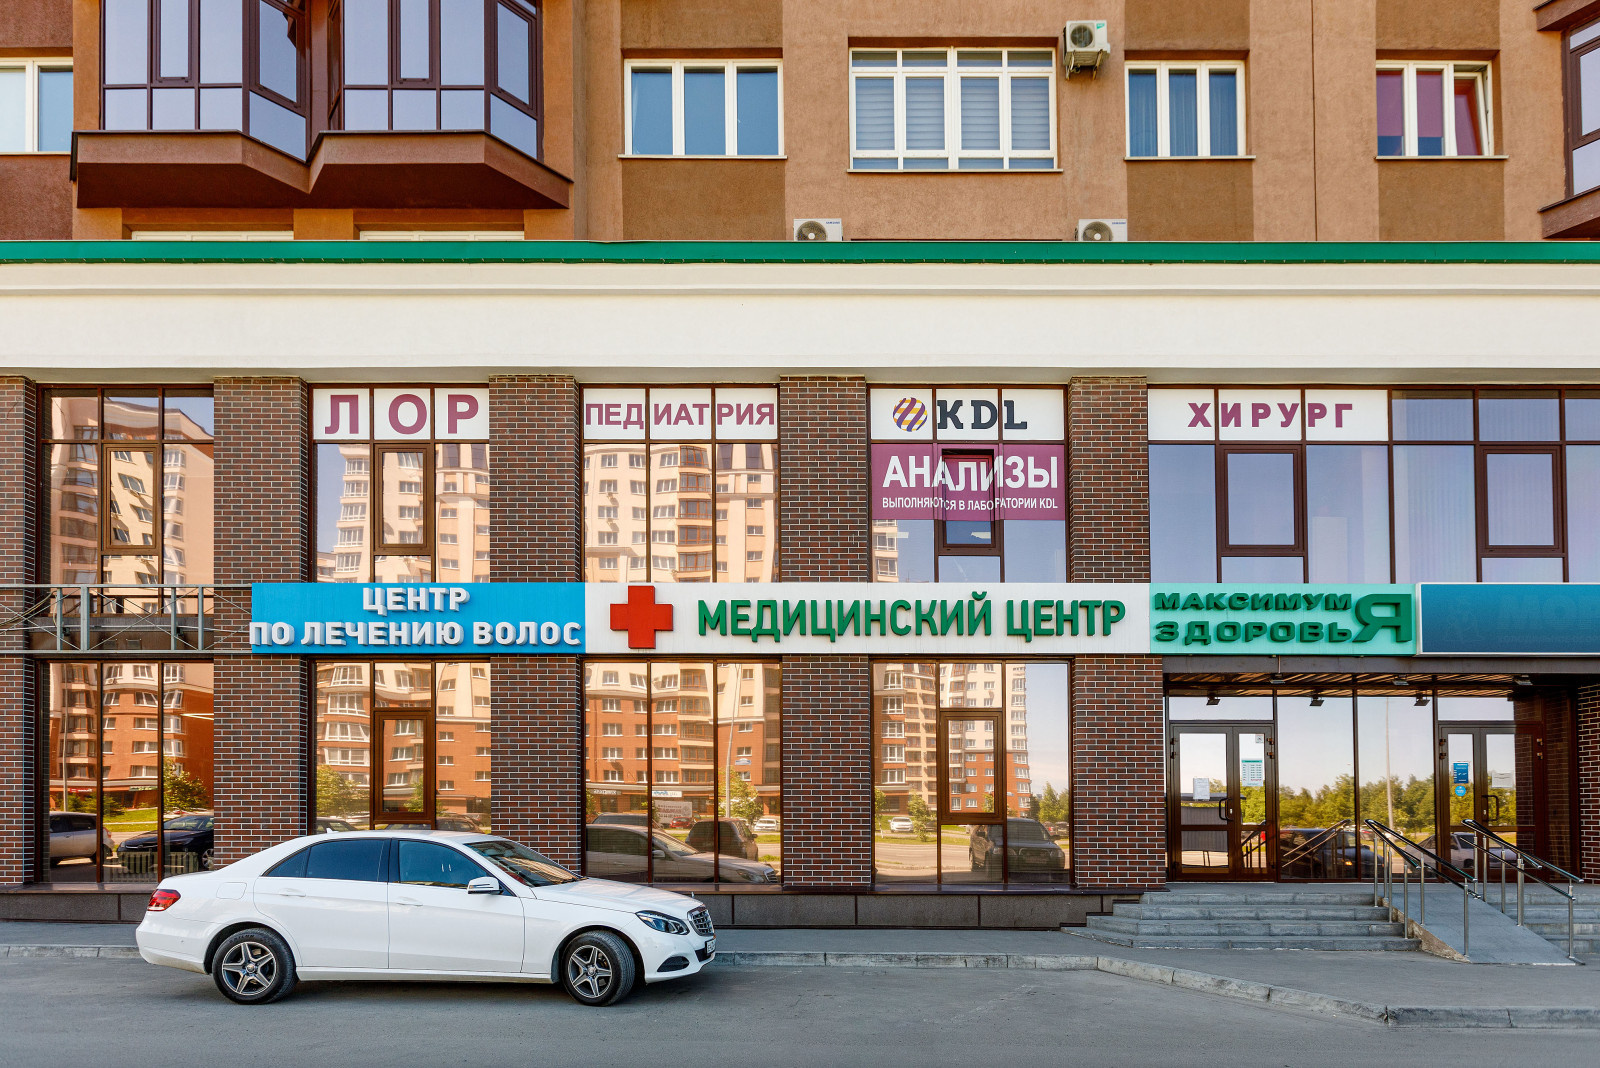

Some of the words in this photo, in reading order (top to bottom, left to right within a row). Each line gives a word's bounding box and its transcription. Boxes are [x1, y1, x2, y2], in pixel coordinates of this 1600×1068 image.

[325, 394, 479, 435] ЛОР
[585, 403, 775, 429] ПЕДИАТРИЯ
[937, 400, 1028, 430] KDL
[1187, 402, 1353, 428] ХИРУРГ
[882, 455, 1058, 492] АНАЛИЗЫ
[958, 500, 966, 510] В
[967, 498, 1037, 511] ЛАБОРАТОРИИ
[1039, 499, 1058, 509] KDL
[362, 587, 470, 616] ЦЕНТР
[1154, 592, 1353, 611] МАКСИМУМ
[698, 591, 992, 643] МЕДИЦИНСКИЙ
[1006, 600, 1126, 643] ЦЕНТР
[249, 621, 295, 645] ПО
[300, 621, 464, 646] ЛЕЧЕНИЮ
[472, 621, 582, 646] ВОЛОС
